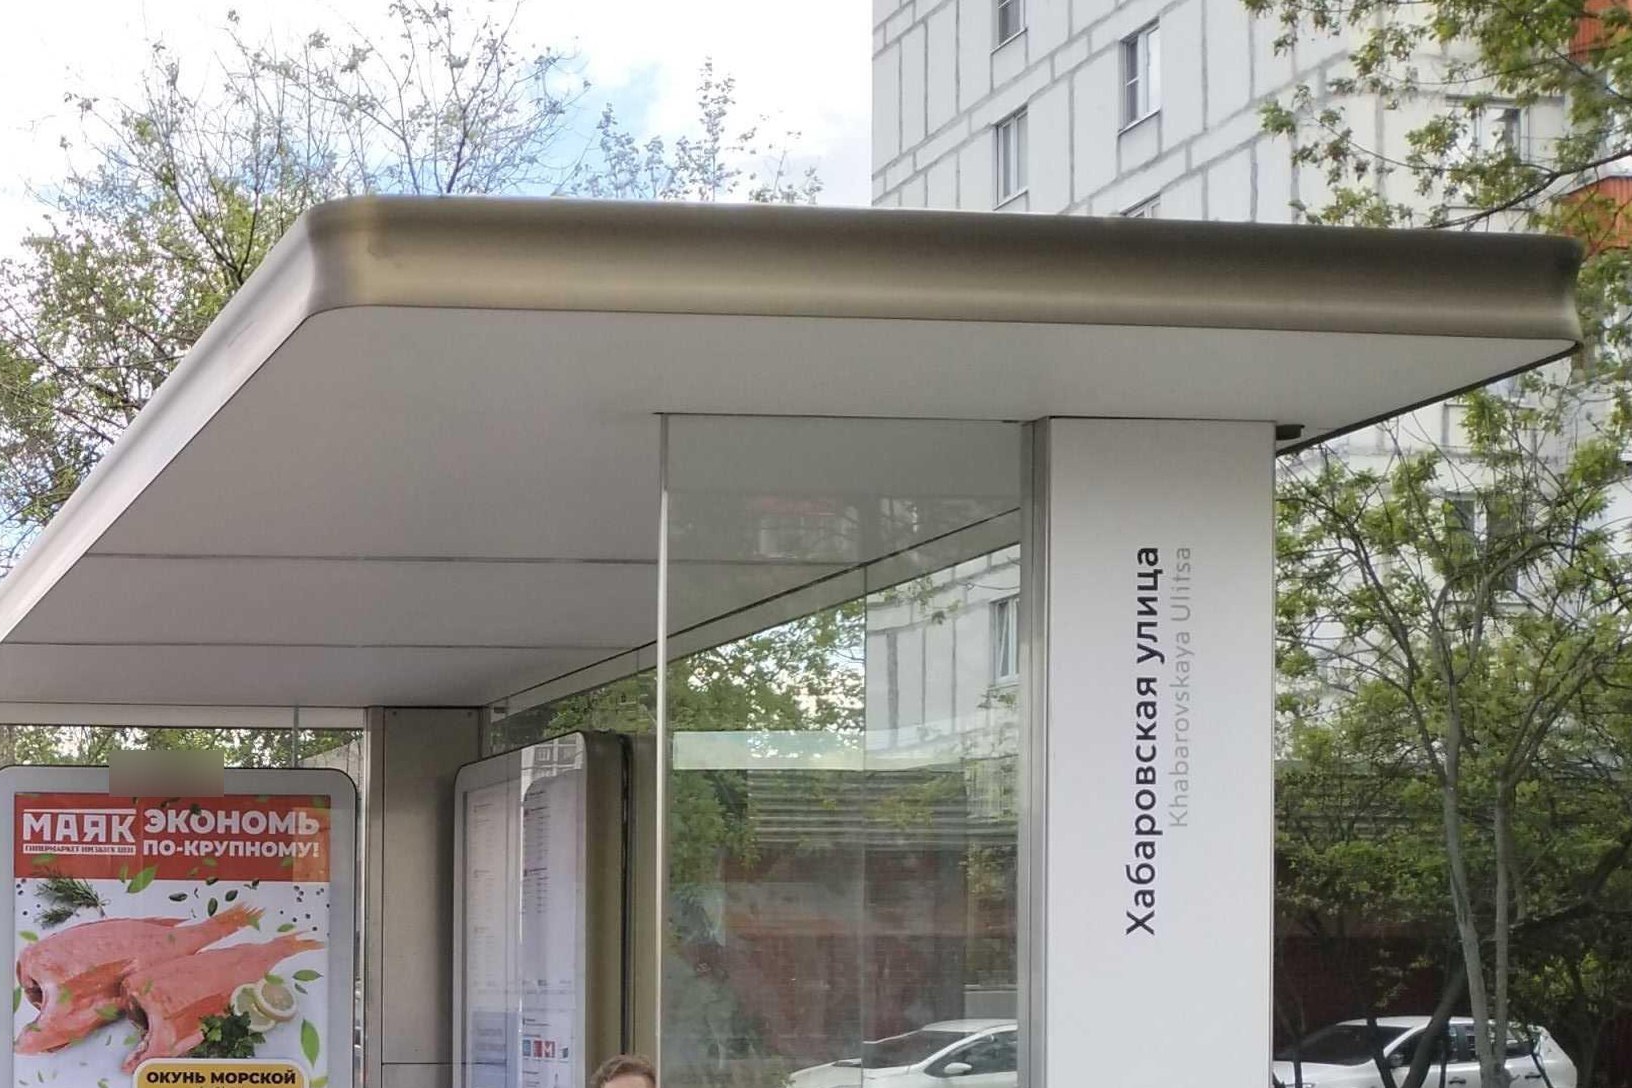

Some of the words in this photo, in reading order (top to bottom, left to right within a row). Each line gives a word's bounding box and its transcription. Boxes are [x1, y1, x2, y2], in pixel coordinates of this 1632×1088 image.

[1136, 547, 1165, 665] улица
[1169, 547, 1192, 622] Ulitsa
[1168, 631, 1195, 828] Khabarovskaya
[22, 812, 137, 844] МАЯК
[143, 809, 321, 836] ЭКОНОМЬ
[1125, 677, 1164, 936] Хабаровская
[143, 839, 320, 859] ПО-КРУПНОМУ!
[146, 1071, 206, 1084] ОКУНЬ
[211, 1069, 296, 1084] МОРСКОЙ
